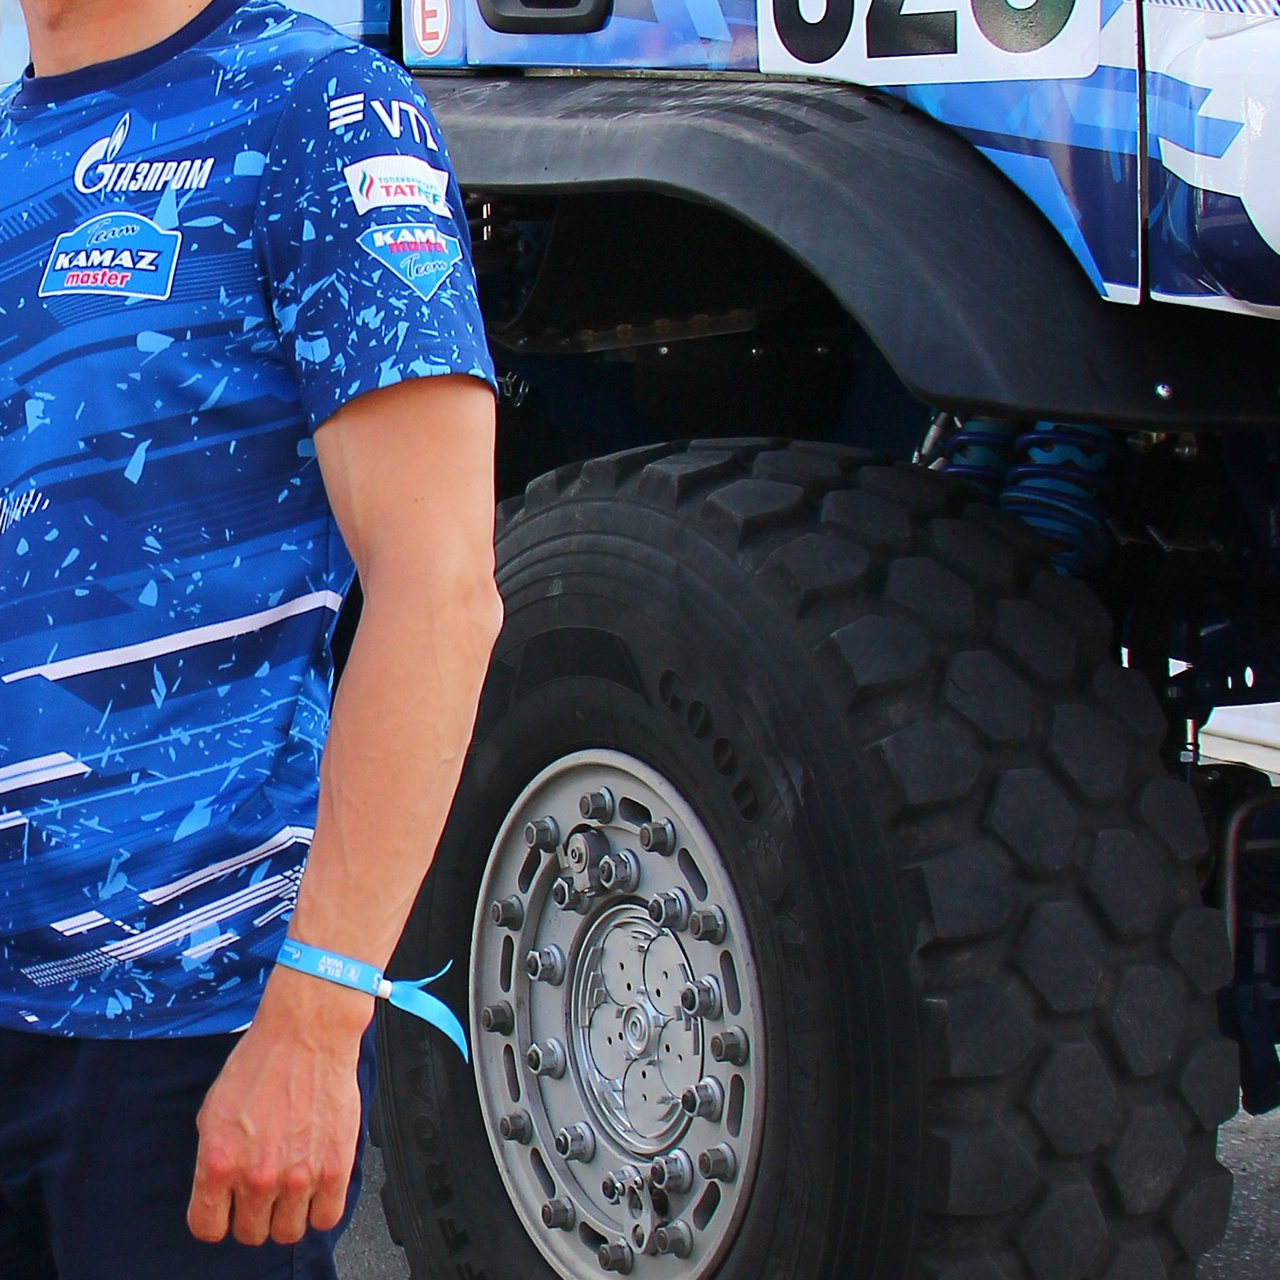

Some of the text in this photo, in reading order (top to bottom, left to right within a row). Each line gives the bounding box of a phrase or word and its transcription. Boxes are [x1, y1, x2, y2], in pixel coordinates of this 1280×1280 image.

[104, 157, 216, 192] ГАЗПРОМ
[380, 184, 443, 206] TATNEF
[86, 218, 140, 247] Team
[54, 249, 159, 271] KAMAZ
[400, 253, 448, 280] Team
[64, 268, 130, 287] master
